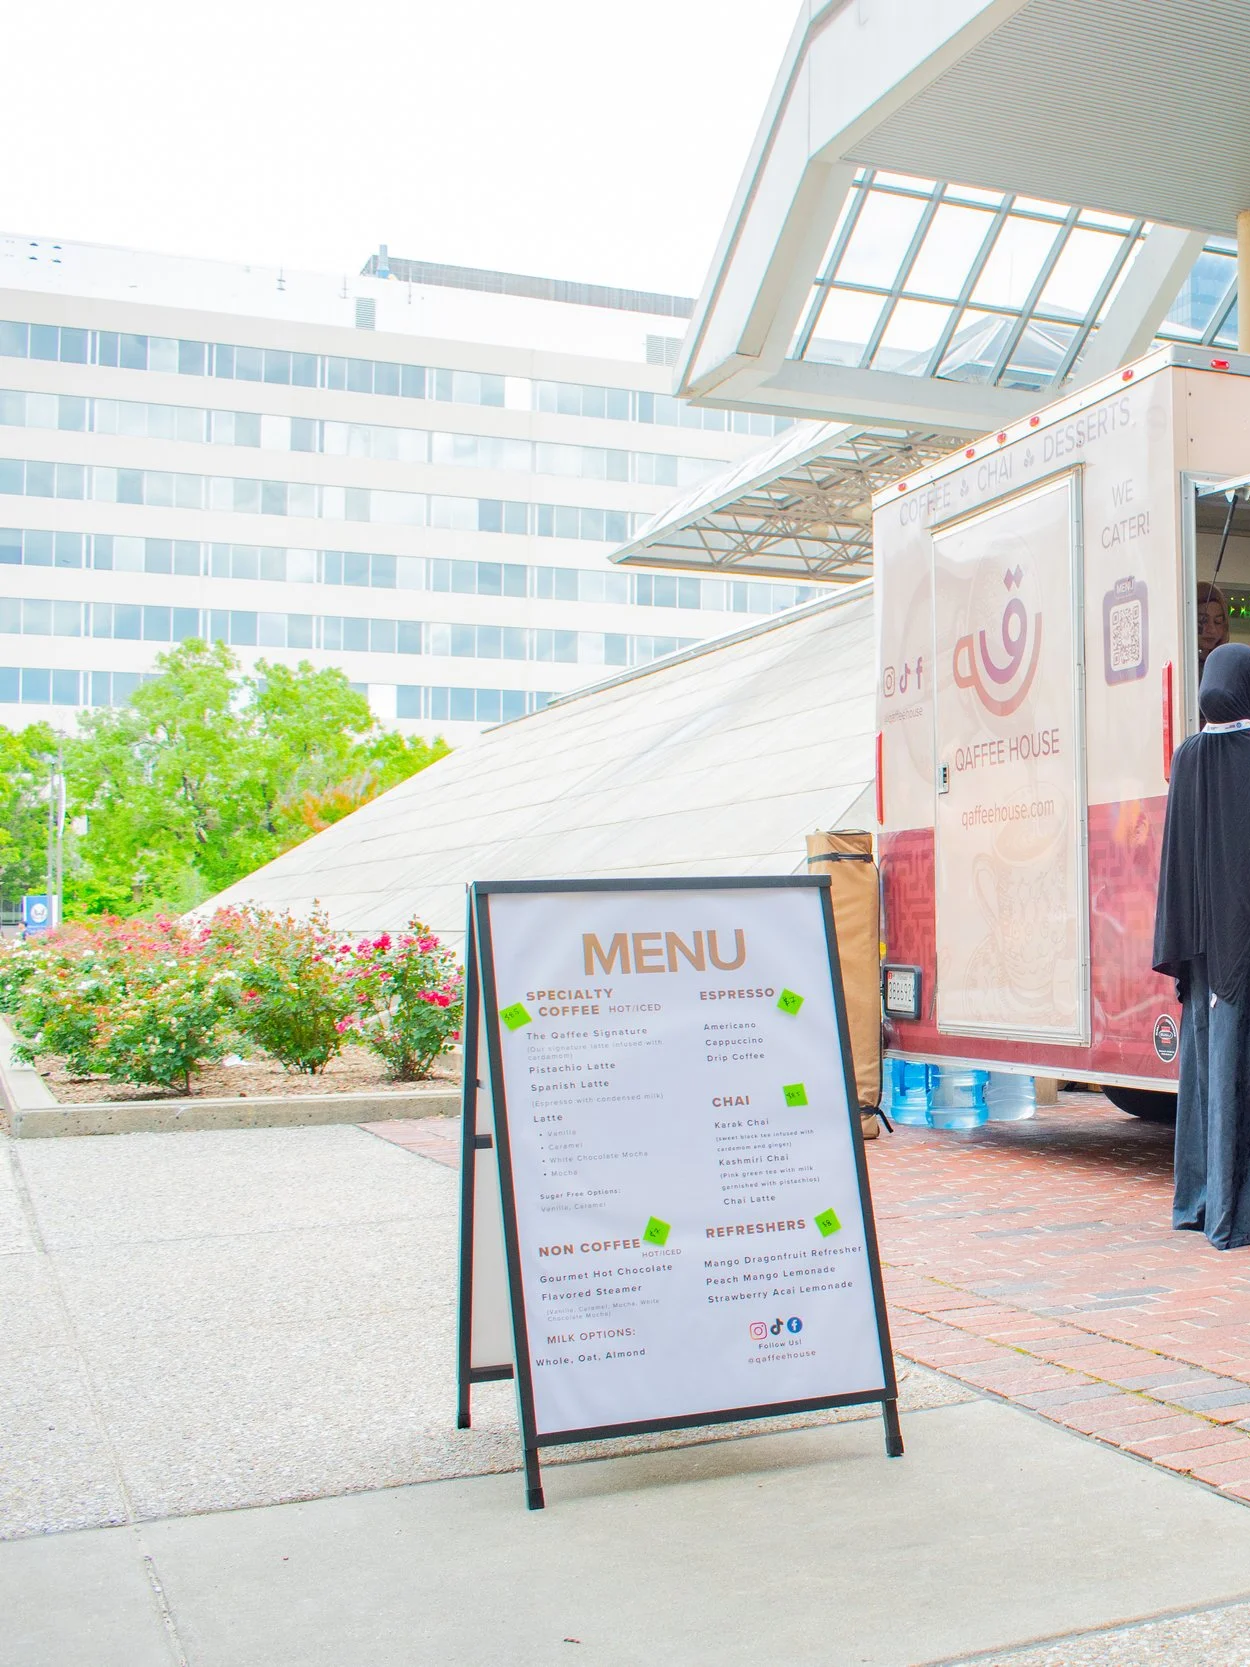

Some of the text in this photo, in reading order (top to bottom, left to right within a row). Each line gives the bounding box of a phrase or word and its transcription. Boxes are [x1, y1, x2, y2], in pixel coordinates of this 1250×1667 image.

[900, 397, 1130, 527] COFFEE CHAI DESSERTS
[1112, 479, 1134, 508] WE
[1102, 511, 1150, 549] CATER!
[955, 729, 1059, 771] QAFFEE HOUSE
[962, 800, 1054, 830] qaffeehouse.com
[582, 928, 747, 976] MENU
[526, 989, 613, 1001] SPECIALTY
[700, 988, 774, 1000] ESPRESSO
[539, 1004, 662, 1016] COFFEE HOT/ICED
[704, 1022, 756, 1030] Americano
[527, 1028, 647, 1040] The Qaffee Signature
[548, 1044, 586, 1052] signature
[706, 1037, 763, 1047] Cappuccino
[529, 1062, 615, 1074] Pistachio Latte
[531, 1080, 609, 1092] Spanish Latte
[532, 1099, 573, 1108] (Espresso
[597, 1094, 640, 1102] condensed
[712, 1096, 750, 1107] CHAI
[534, 1114, 563, 1123] Latte
[747, 1118, 769, 1126] Chai
[550, 1156, 573, 1164] White
[577, 1153, 619, 1161] Chocolate
[719, 1156, 762, 1166] Kashmiri
[587, 1188, 621, 1196] Options:
[722, 1183, 758, 1191] garnished
[724, 1197, 746, 1205] Chai
[706, 1219, 805, 1238] REFRESHERS
[539, 1239, 640, 1257] NON COFFEE
[642, 1249, 681, 1258] HOT/ICED
[705, 1245, 861, 1267] Mango Dragonfruit Refresher
[540, 1272, 588, 1283] Gourmet
[618, 1264, 673, 1275] Chocolate
[706, 1266, 835, 1285] Peach Mango Lemonade
[542, 1285, 642, 1300] Flavored Steamer
[708, 1281, 853, 1303] Strawberry Acai Lemonade
[548, 1328, 635, 1344] MILK OPTIONS:
[759, 1341, 785, 1350] Follow
[536, 1348, 646, 1366] Whole, Oat, Almond
[748, 1350, 816, 1364] @qaffeehouse
